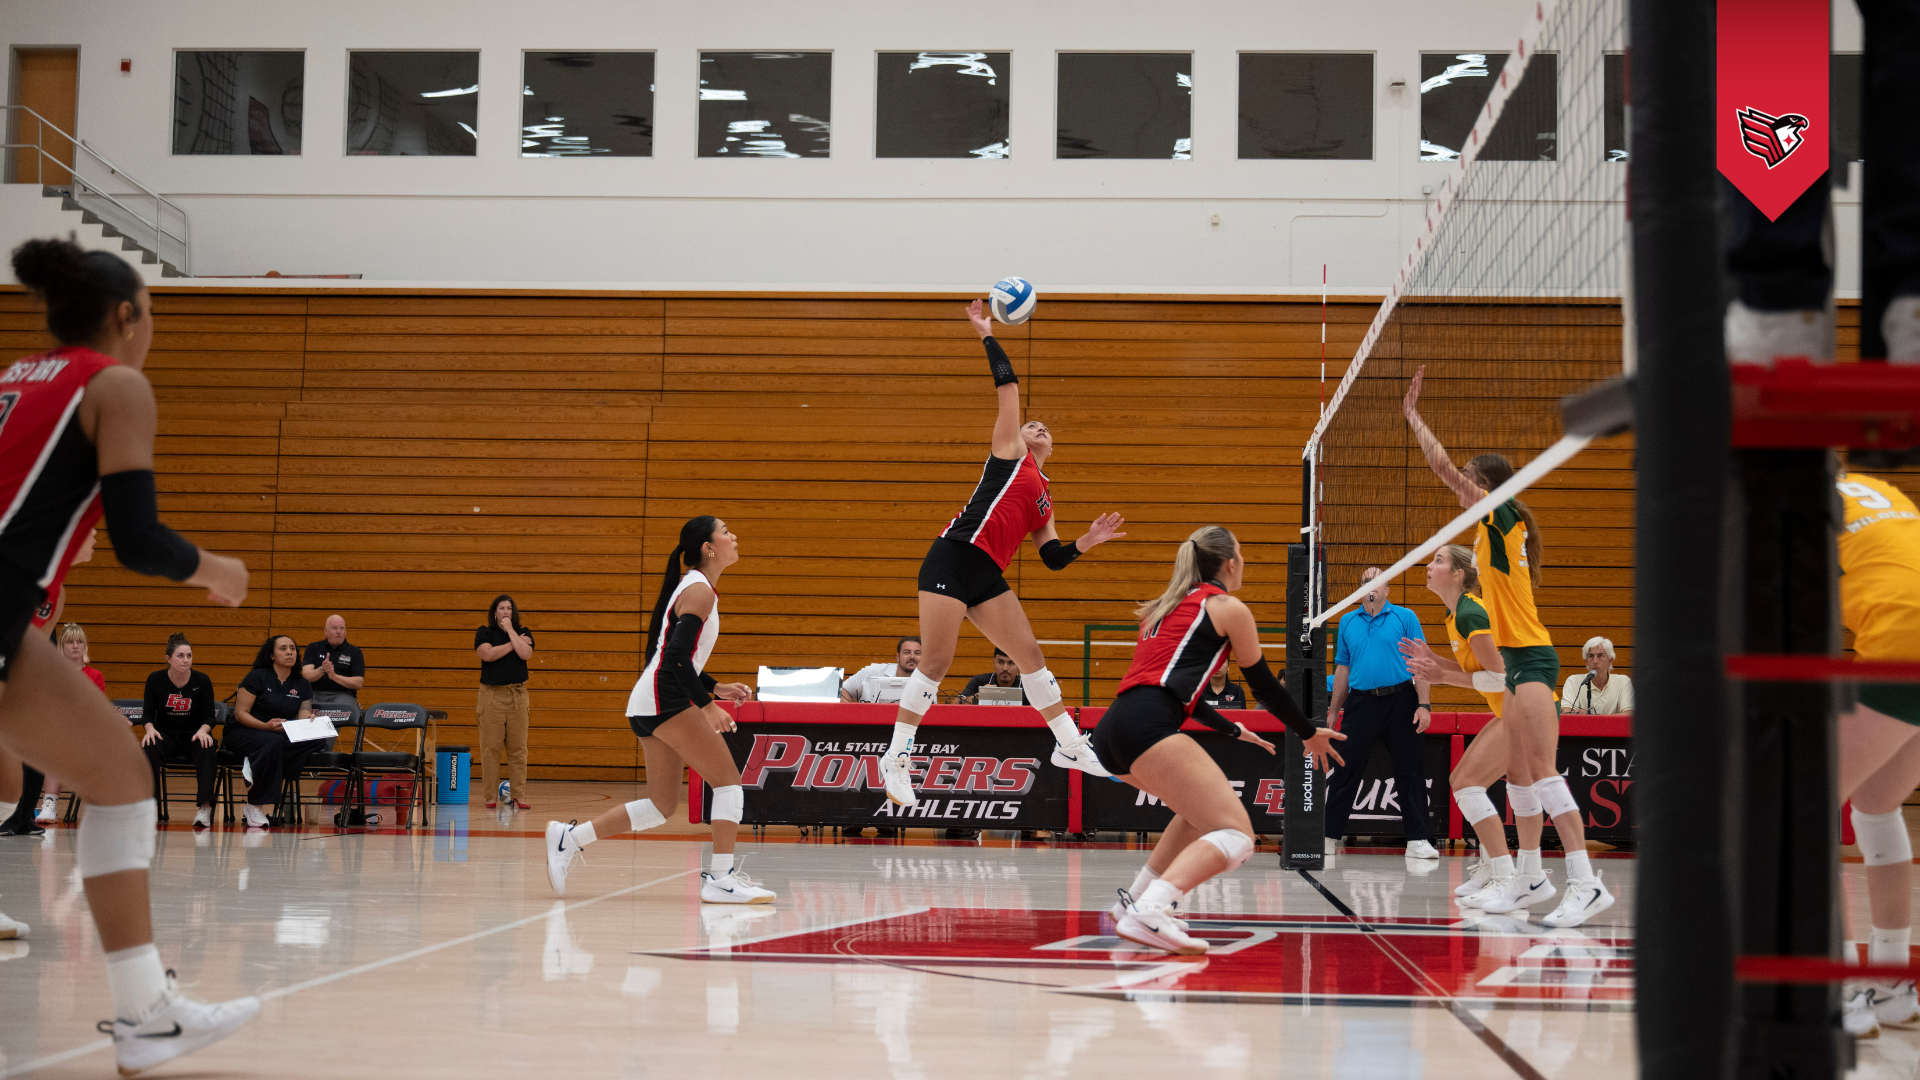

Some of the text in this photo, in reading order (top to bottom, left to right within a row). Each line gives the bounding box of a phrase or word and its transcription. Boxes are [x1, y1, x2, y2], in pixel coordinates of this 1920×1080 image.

[1835, 482, 1892, 509] 9
[815, 742, 960, 754] CAL STATE ST BAY
[1302, 770, 1314, 812] imports
[873, 799, 1022, 820] ATHLETICS
